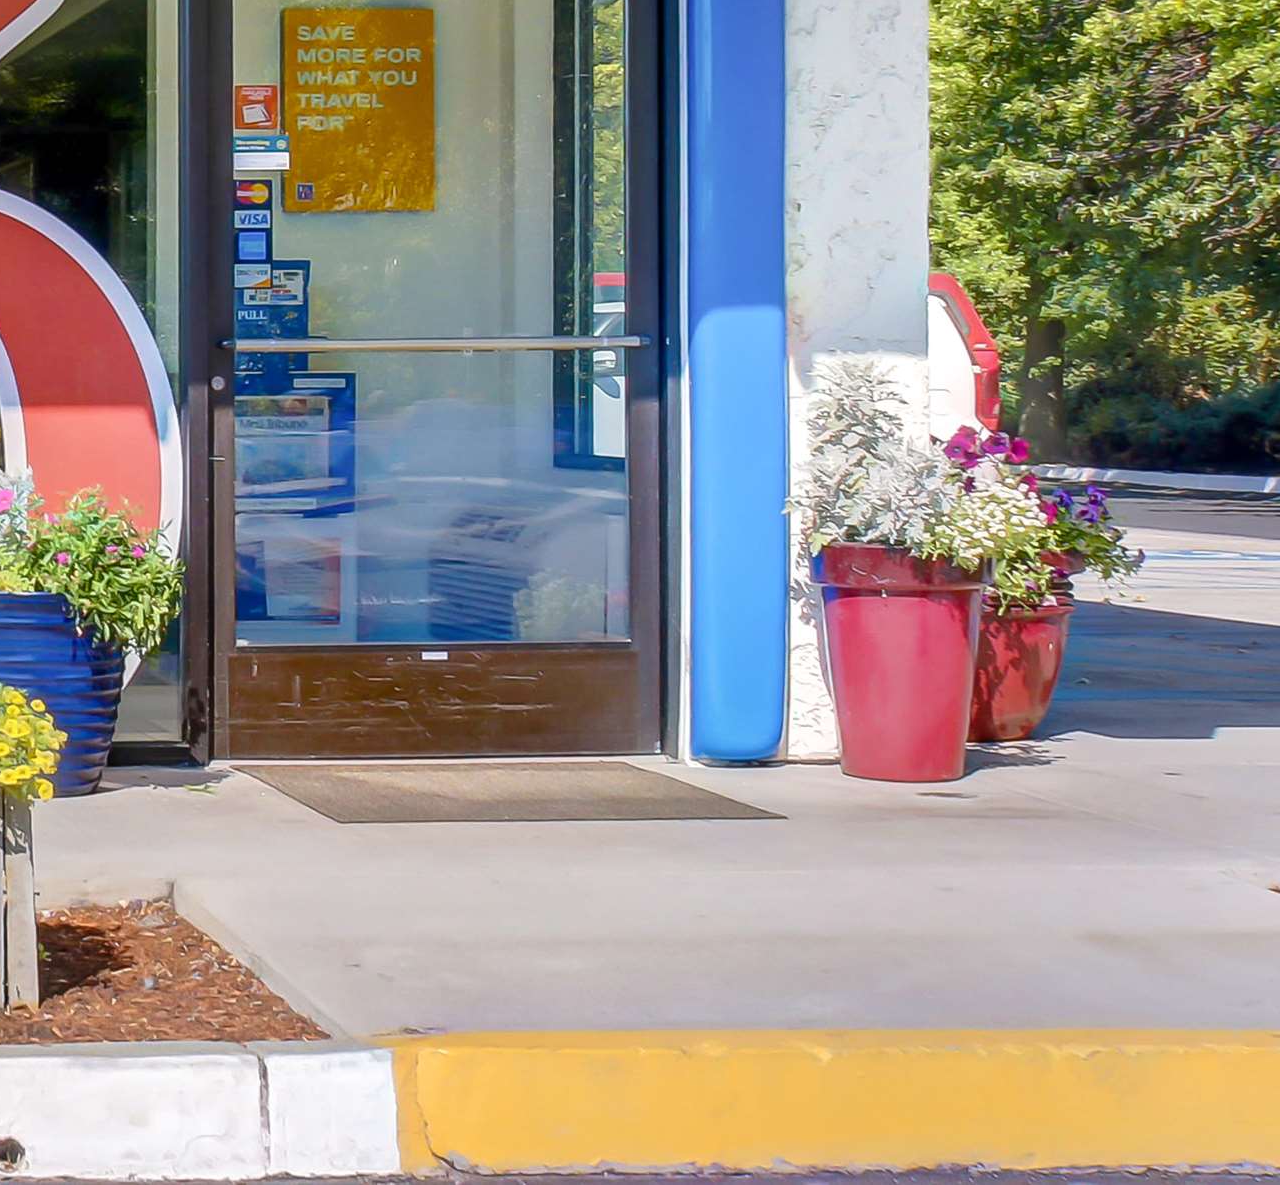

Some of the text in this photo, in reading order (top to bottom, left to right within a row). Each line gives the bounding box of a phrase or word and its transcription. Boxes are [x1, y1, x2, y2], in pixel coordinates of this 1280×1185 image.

[297, 25, 355, 41] SAVE
[297, 47, 421, 63] MORE FOR
[297, 69, 418, 85] WHAT YOU
[296, 92, 385, 108] TRAVEL
[239, 214, 269, 225] VISA
[237, 309, 268, 320] PULL
